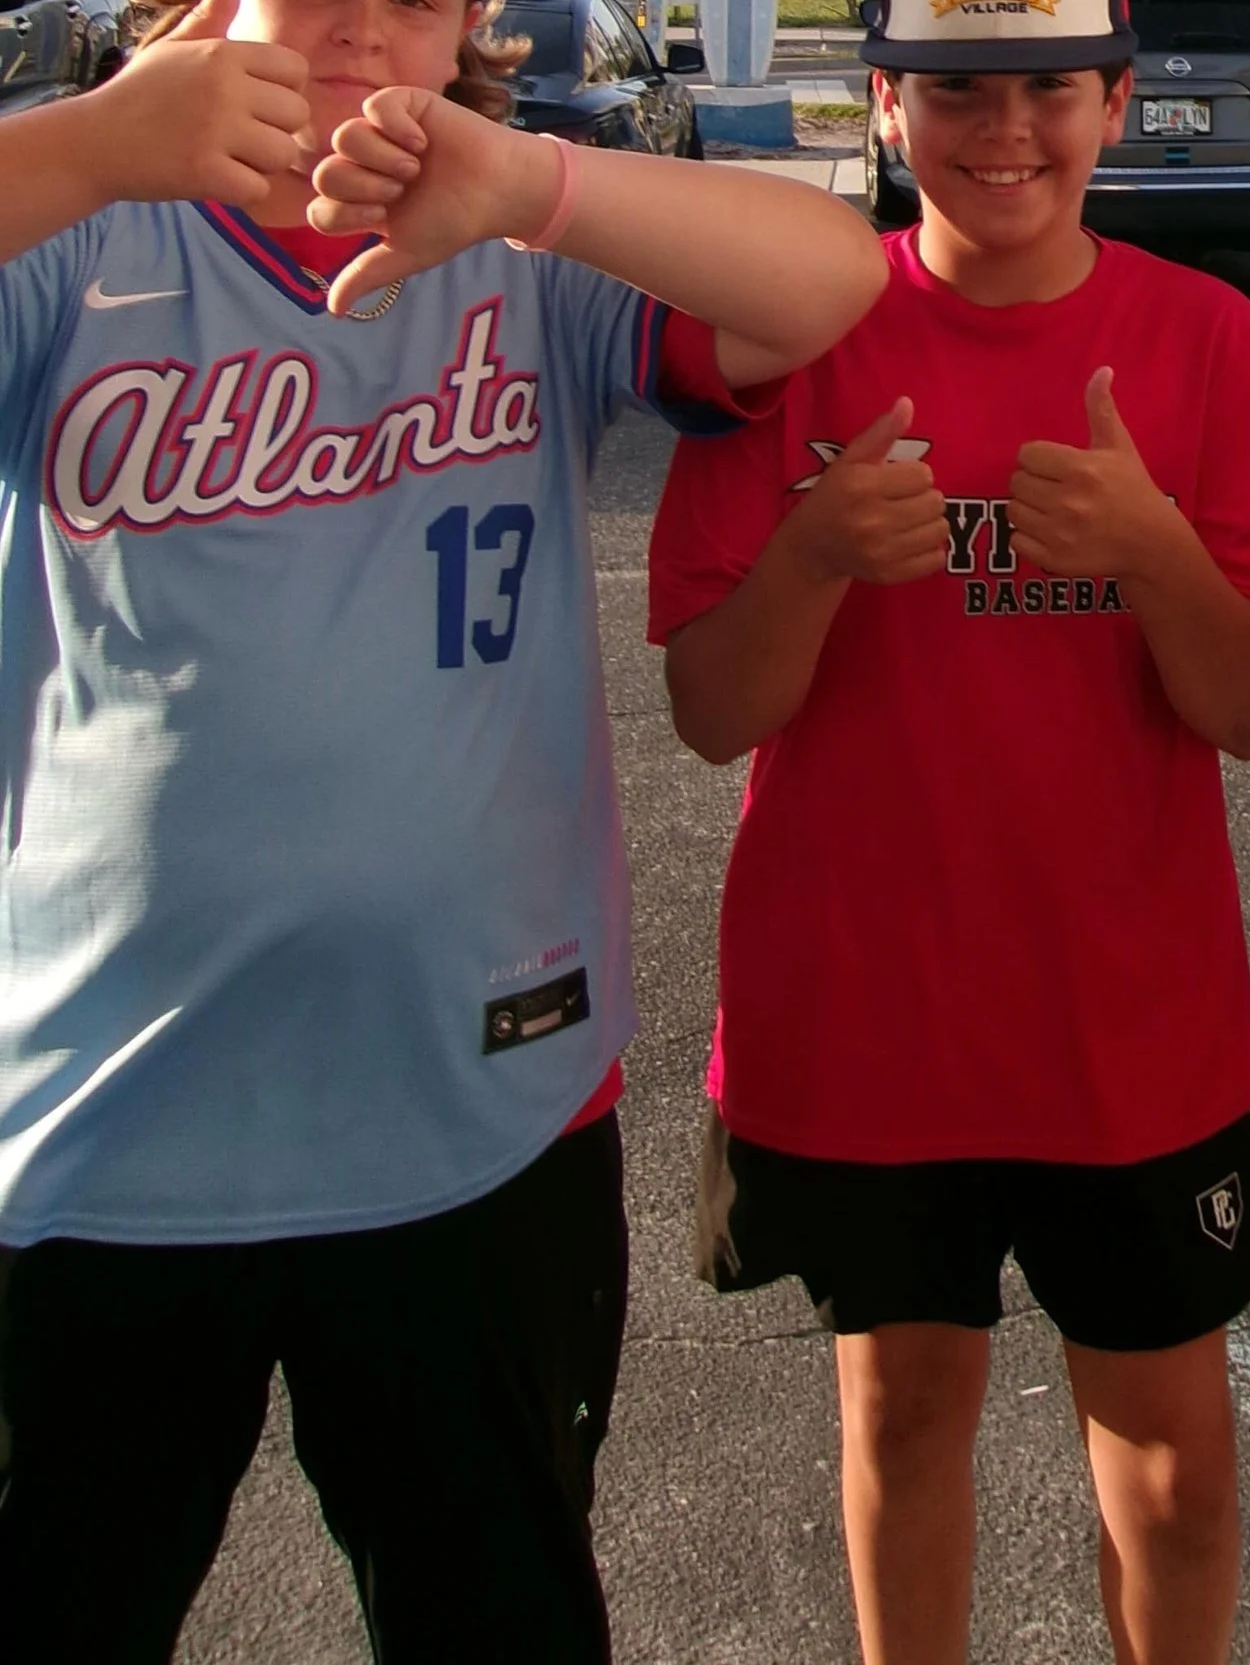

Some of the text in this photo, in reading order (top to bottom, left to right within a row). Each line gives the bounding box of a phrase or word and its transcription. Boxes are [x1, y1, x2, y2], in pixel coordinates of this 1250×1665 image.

[960, 1, 1029, 15] VILLAGE
[44, 295, 541, 542] Atlanta
[425, 503, 535, 670] 13
[964, 577, 1132, 616] BASEBA
